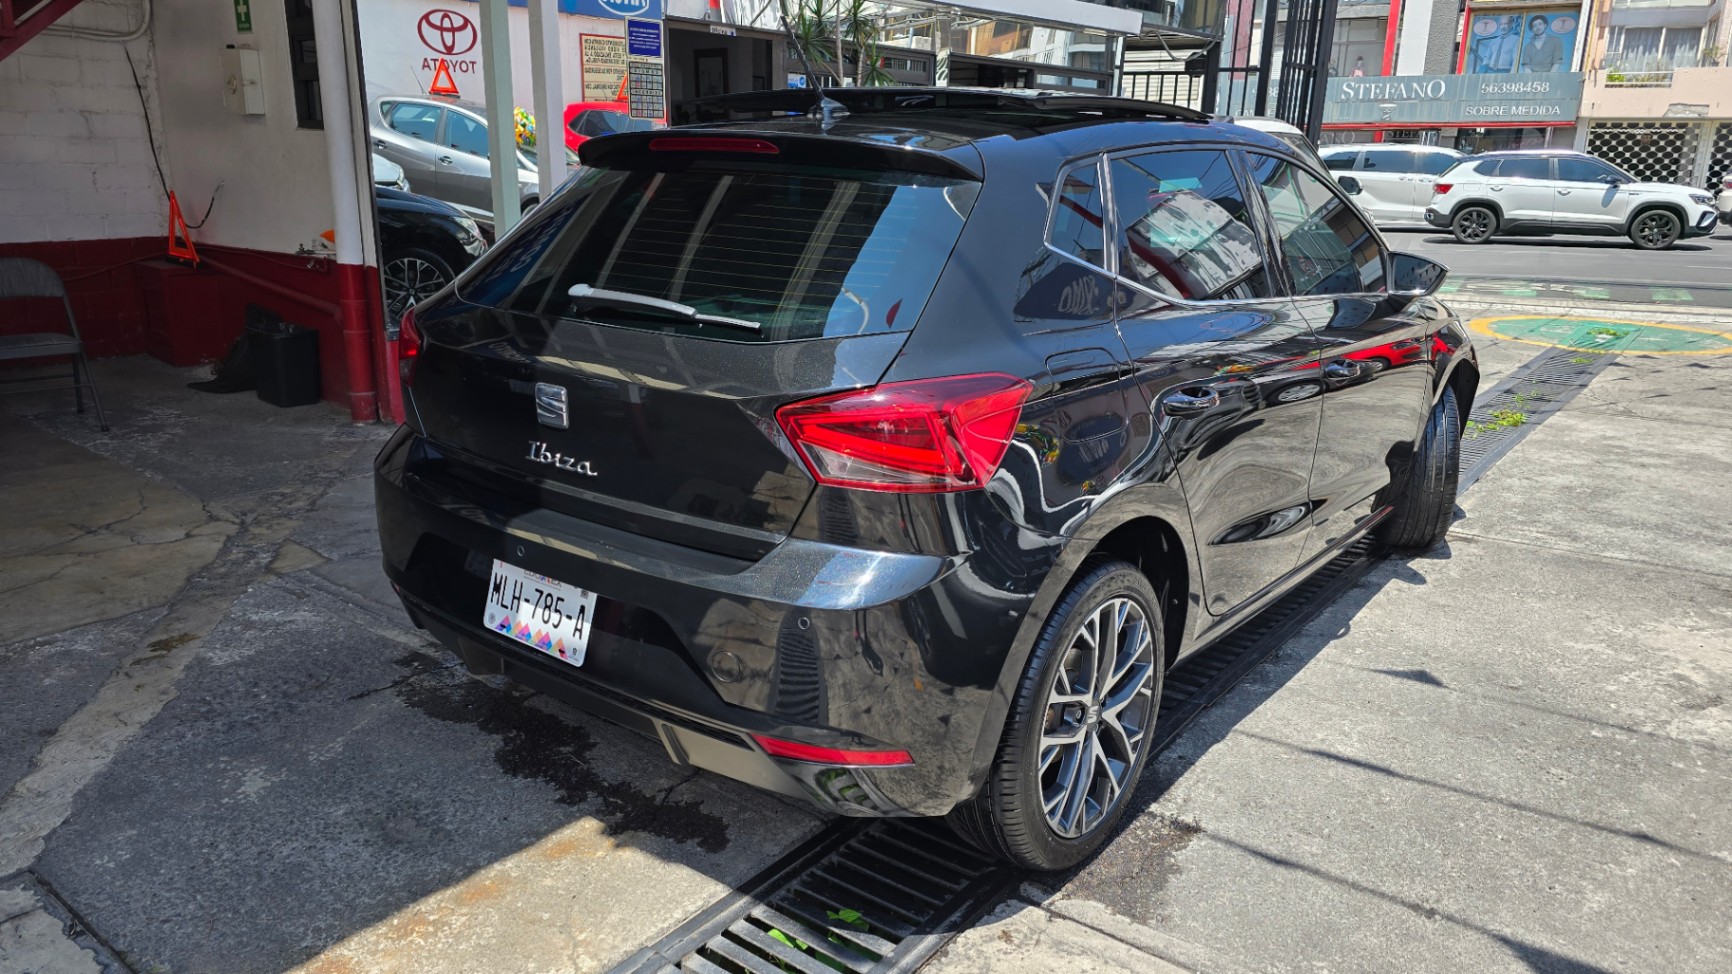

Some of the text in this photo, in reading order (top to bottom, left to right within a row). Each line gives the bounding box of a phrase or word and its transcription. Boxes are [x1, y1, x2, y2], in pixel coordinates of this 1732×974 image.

[1341, 80, 1446, 99] STEFANO
[1481, 82, 1550, 94] 56398458
[1465, 106, 1560, 116] SOBRE MEDIDA
[525, 441, 598, 476] Ibiza
[490, 571, 586, 640] MLH-785-A
